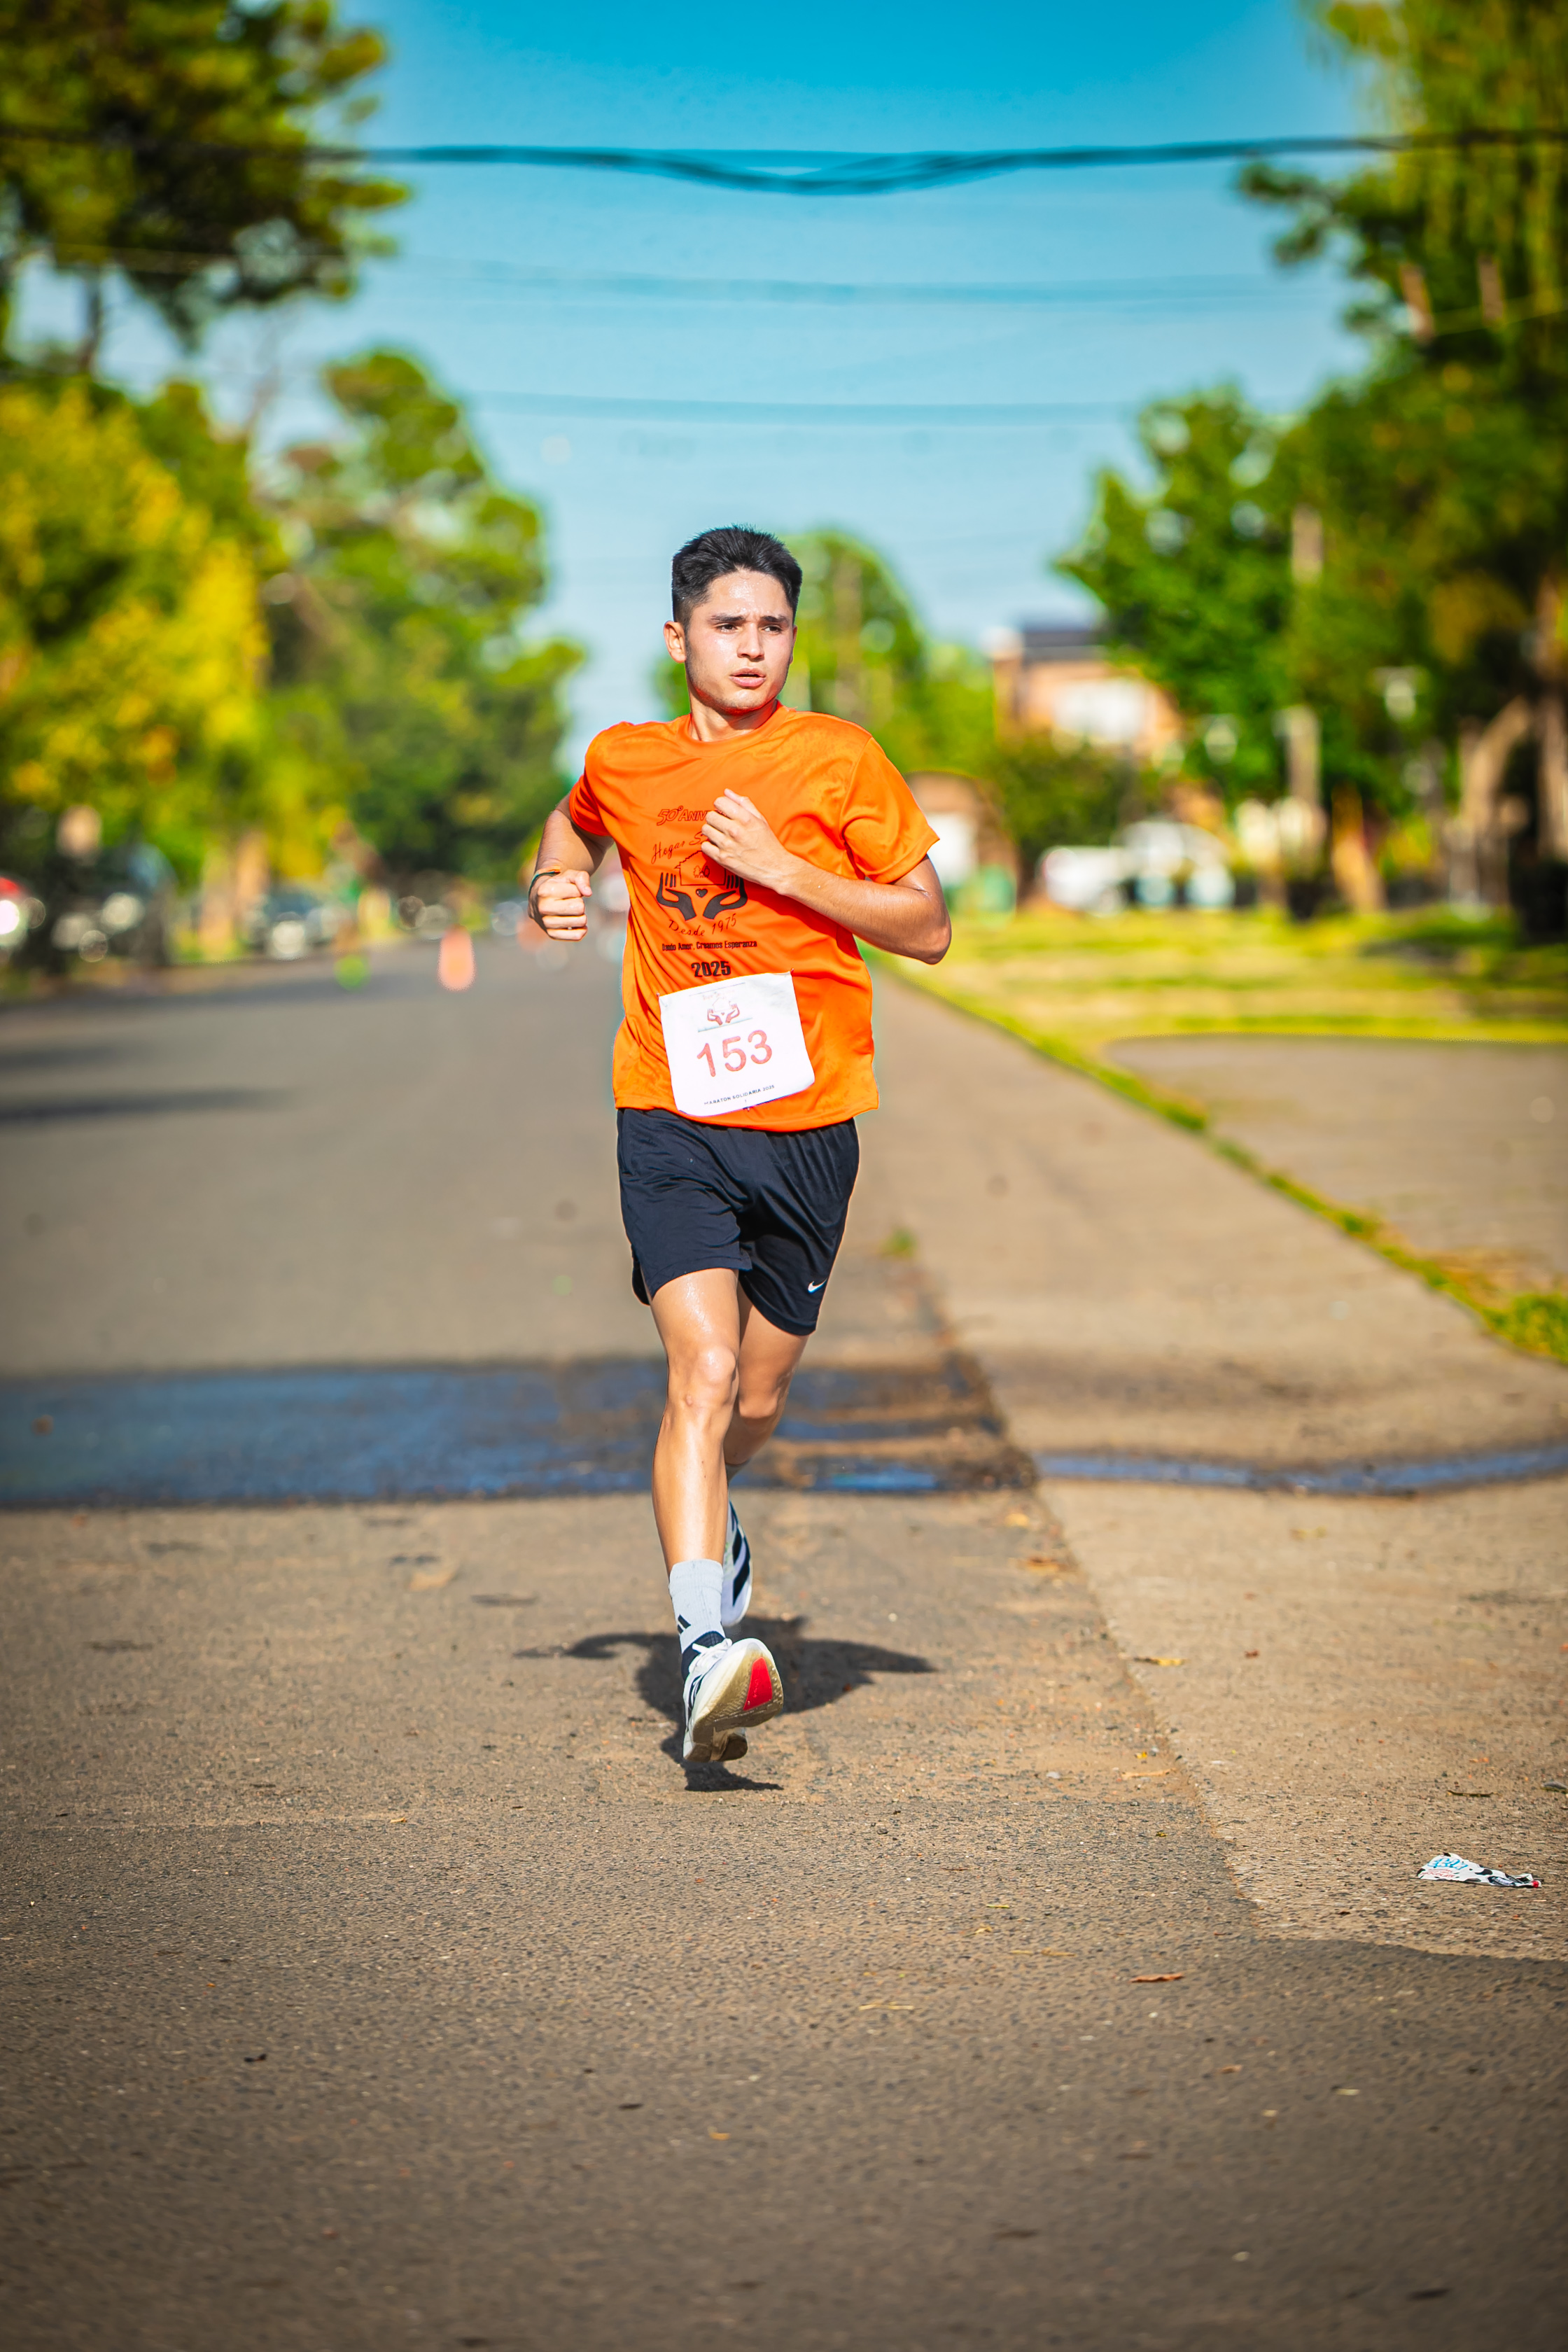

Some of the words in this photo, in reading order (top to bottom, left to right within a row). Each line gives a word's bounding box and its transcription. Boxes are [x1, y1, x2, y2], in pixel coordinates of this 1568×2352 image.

[651, 841, 685, 864] Hogar
[668, 919, 705, 937] Desde
[711, 913, 736, 935] 1975
[696, 941, 723, 950] Creamos
[724, 940, 757, 950] Esperanza
[691, 960, 731, 977] 2025
[696, 1029, 773, 1077] 153
[704, 1096, 732, 1105] MARATON
[732, 1088, 762, 1100] SOLIDARIA
